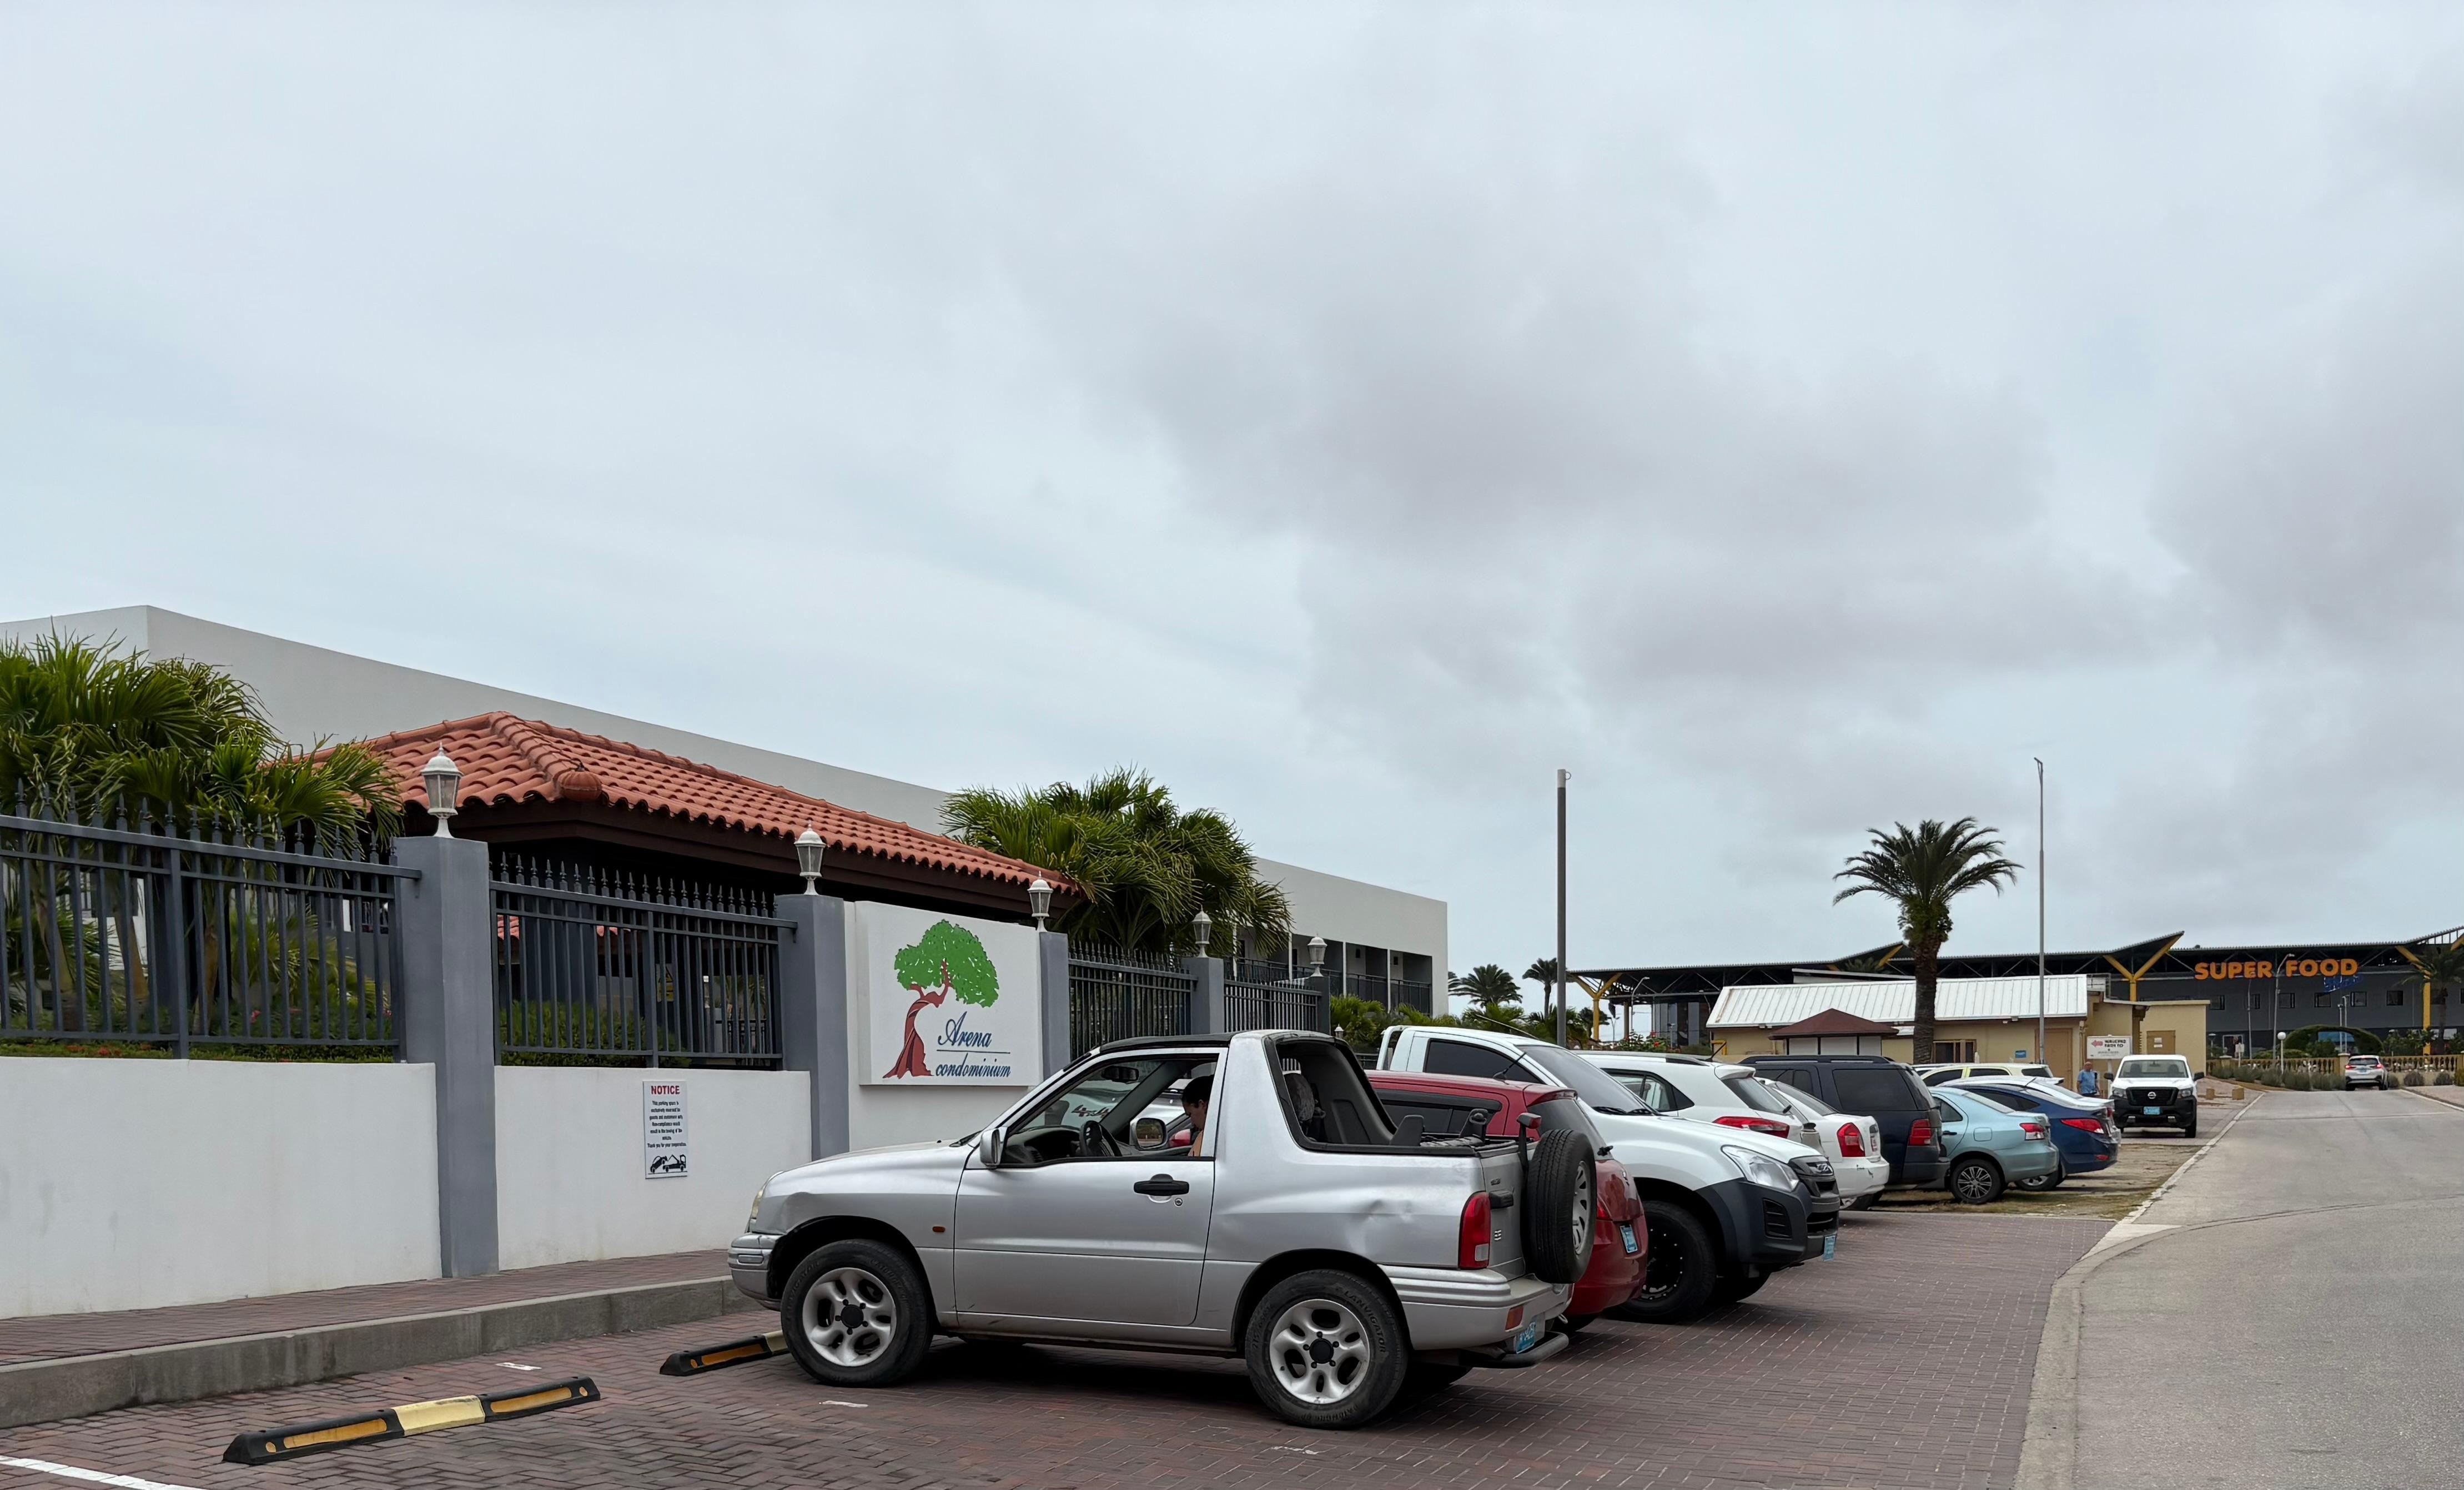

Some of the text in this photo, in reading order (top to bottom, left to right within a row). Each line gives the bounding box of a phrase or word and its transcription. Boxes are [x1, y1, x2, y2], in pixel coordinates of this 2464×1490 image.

[2194, 959, 2358, 980] SUPER FOOD
[938, 1011, 992, 1048] Arena
[936, 1053, 1011, 1077] condominium
[651, 1085, 680, 1095] NOTICE
[1344, 1291, 1386, 1353] LANVIGATOR
